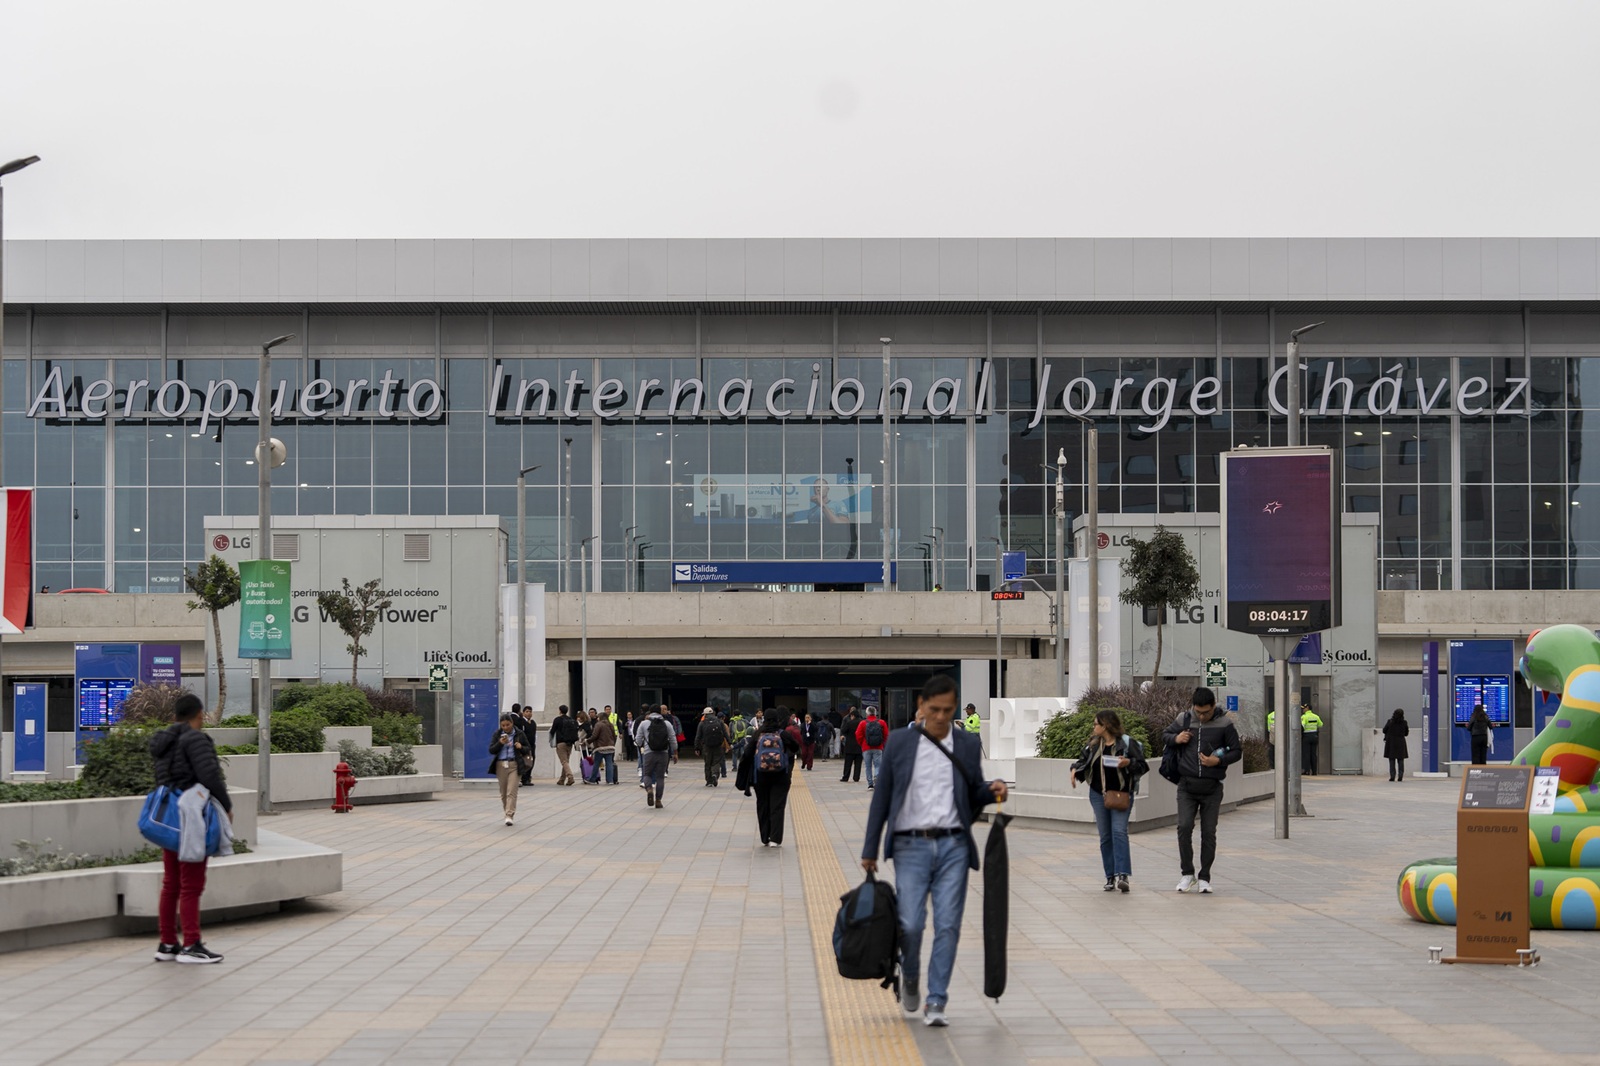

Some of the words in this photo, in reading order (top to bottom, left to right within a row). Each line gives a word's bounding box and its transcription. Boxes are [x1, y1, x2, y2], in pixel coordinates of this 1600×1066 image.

[26, 365, 442, 434] Aeropuerto
[487, 361, 993, 417] Internacional
[1028, 364, 1222, 433] Jorge
[1267, 361, 1531, 416] Chávez
[233, 537, 250, 549] LG
[1113, 535, 1132, 547] LG
[692, 564, 718, 573] Salidas
[692, 572, 729, 582] Departures
[291, 589, 341, 598] perimenta
[345, 588, 354, 597] la
[387, 589, 402, 597] del
[404, 588, 440, 597] océano
[291, 605, 309, 623] G
[1175, 605, 1205, 624] LG
[1249, 610, 1309, 621] 08:04:17
[423, 650, 453, 663] Life's
[455, 650, 492, 663] Good.
[1335, 649, 1371, 662] Good.
